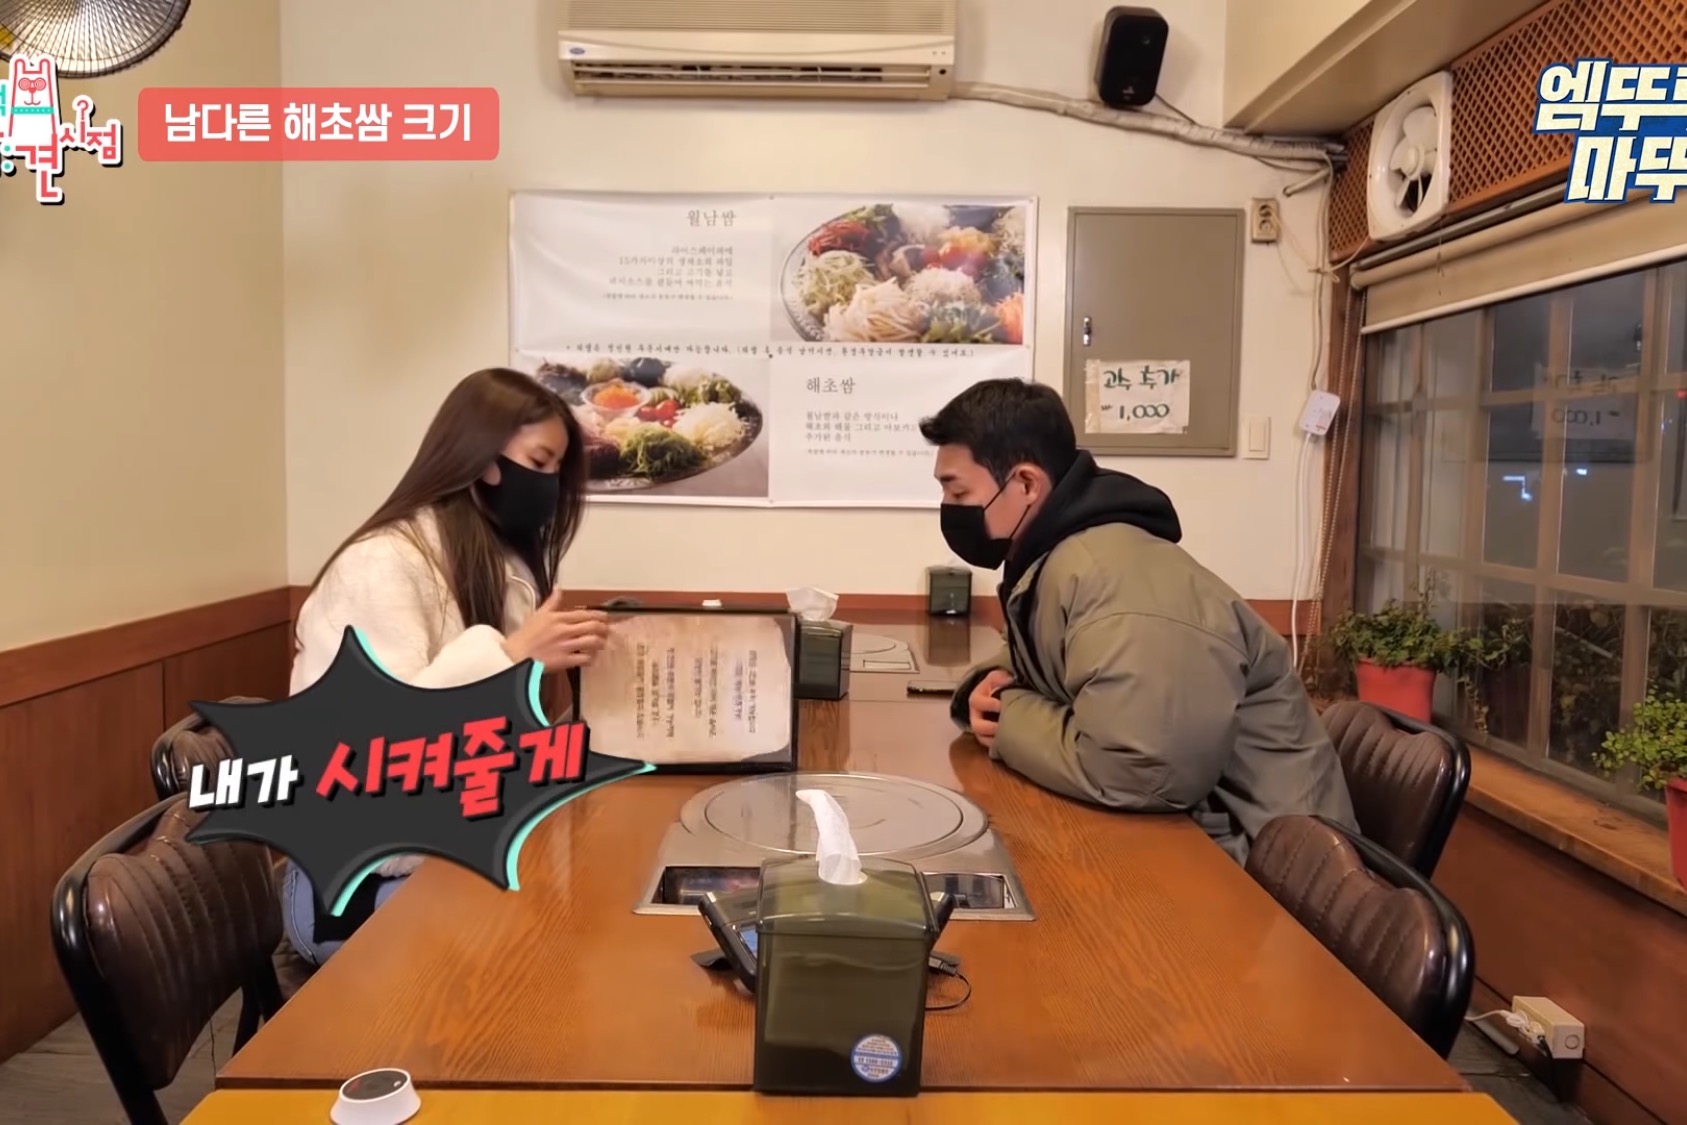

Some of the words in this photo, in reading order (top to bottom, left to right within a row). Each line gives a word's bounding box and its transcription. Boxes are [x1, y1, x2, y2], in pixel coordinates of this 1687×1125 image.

[686, 209, 736, 226] 월남쌈
[806, 376, 856, 394] 해초쌈
[1138, 364, 1181, 390] 추가
[844, 411, 860, 421] 같은
[863, 411, 899, 421] 방식이나
[1119, 403, 1170, 421] 1,000
[854, 423, 881, 433] 그리고
